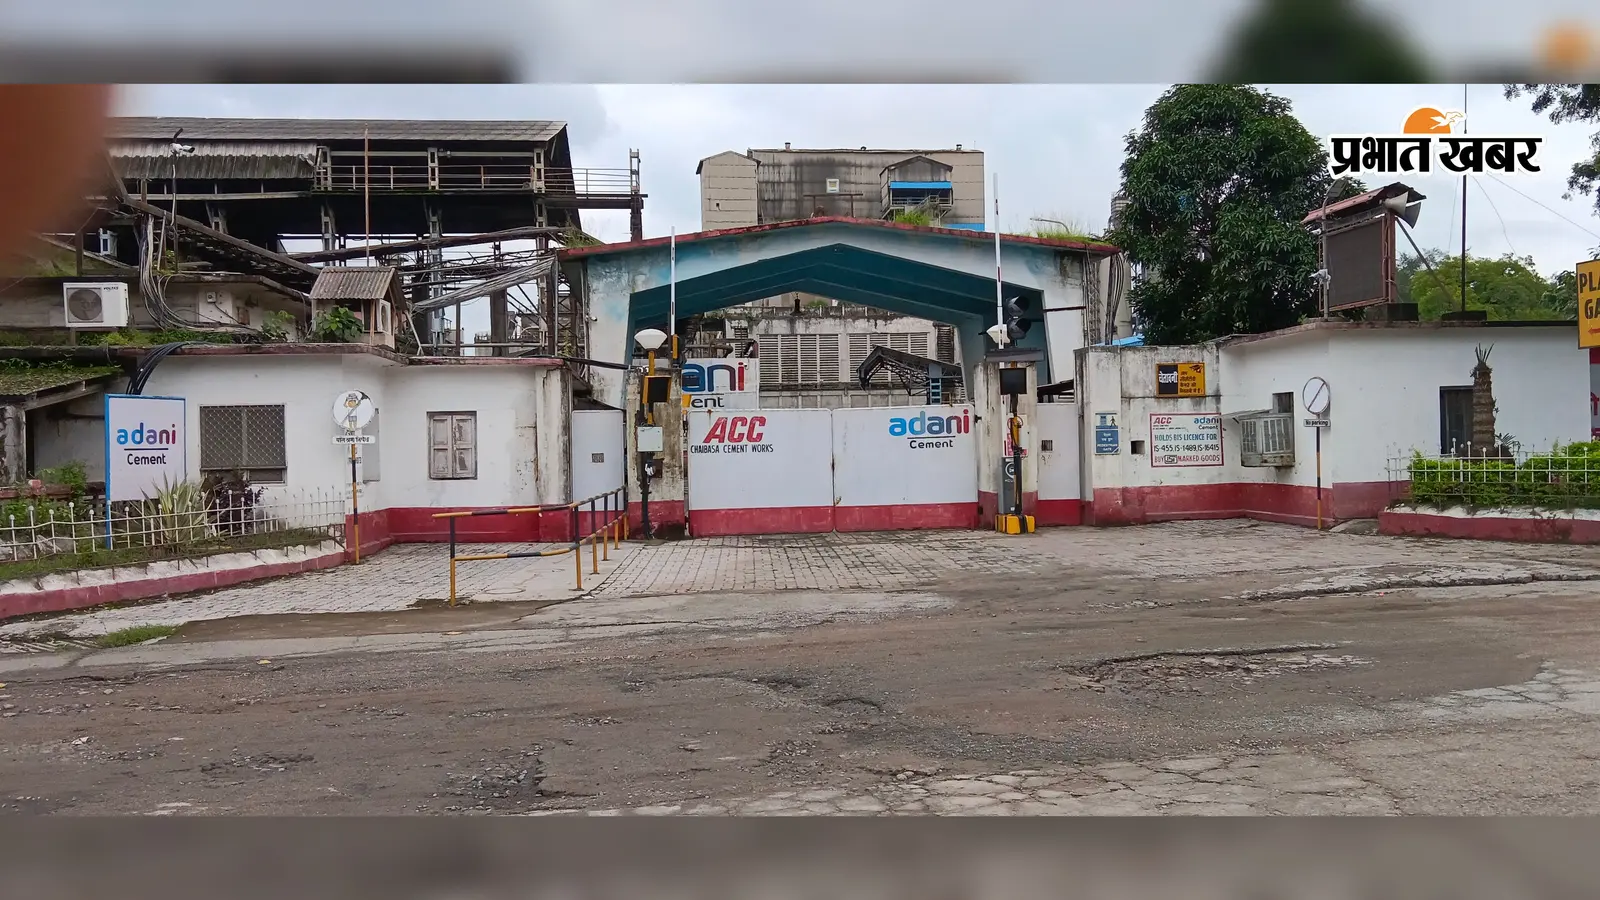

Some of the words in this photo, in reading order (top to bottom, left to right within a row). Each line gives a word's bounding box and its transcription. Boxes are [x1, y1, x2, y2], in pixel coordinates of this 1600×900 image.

[703, 416, 766, 443] ACC
[889, 409, 969, 436] adani
[117, 422, 176, 444] adani
[690, 445, 719, 454] CHAIBASA
[723, 444, 748, 453] CEMENT
[752, 444, 773, 453] WORKS
[910, 440, 953, 449] Cement
[127, 453, 166, 465] Cement
